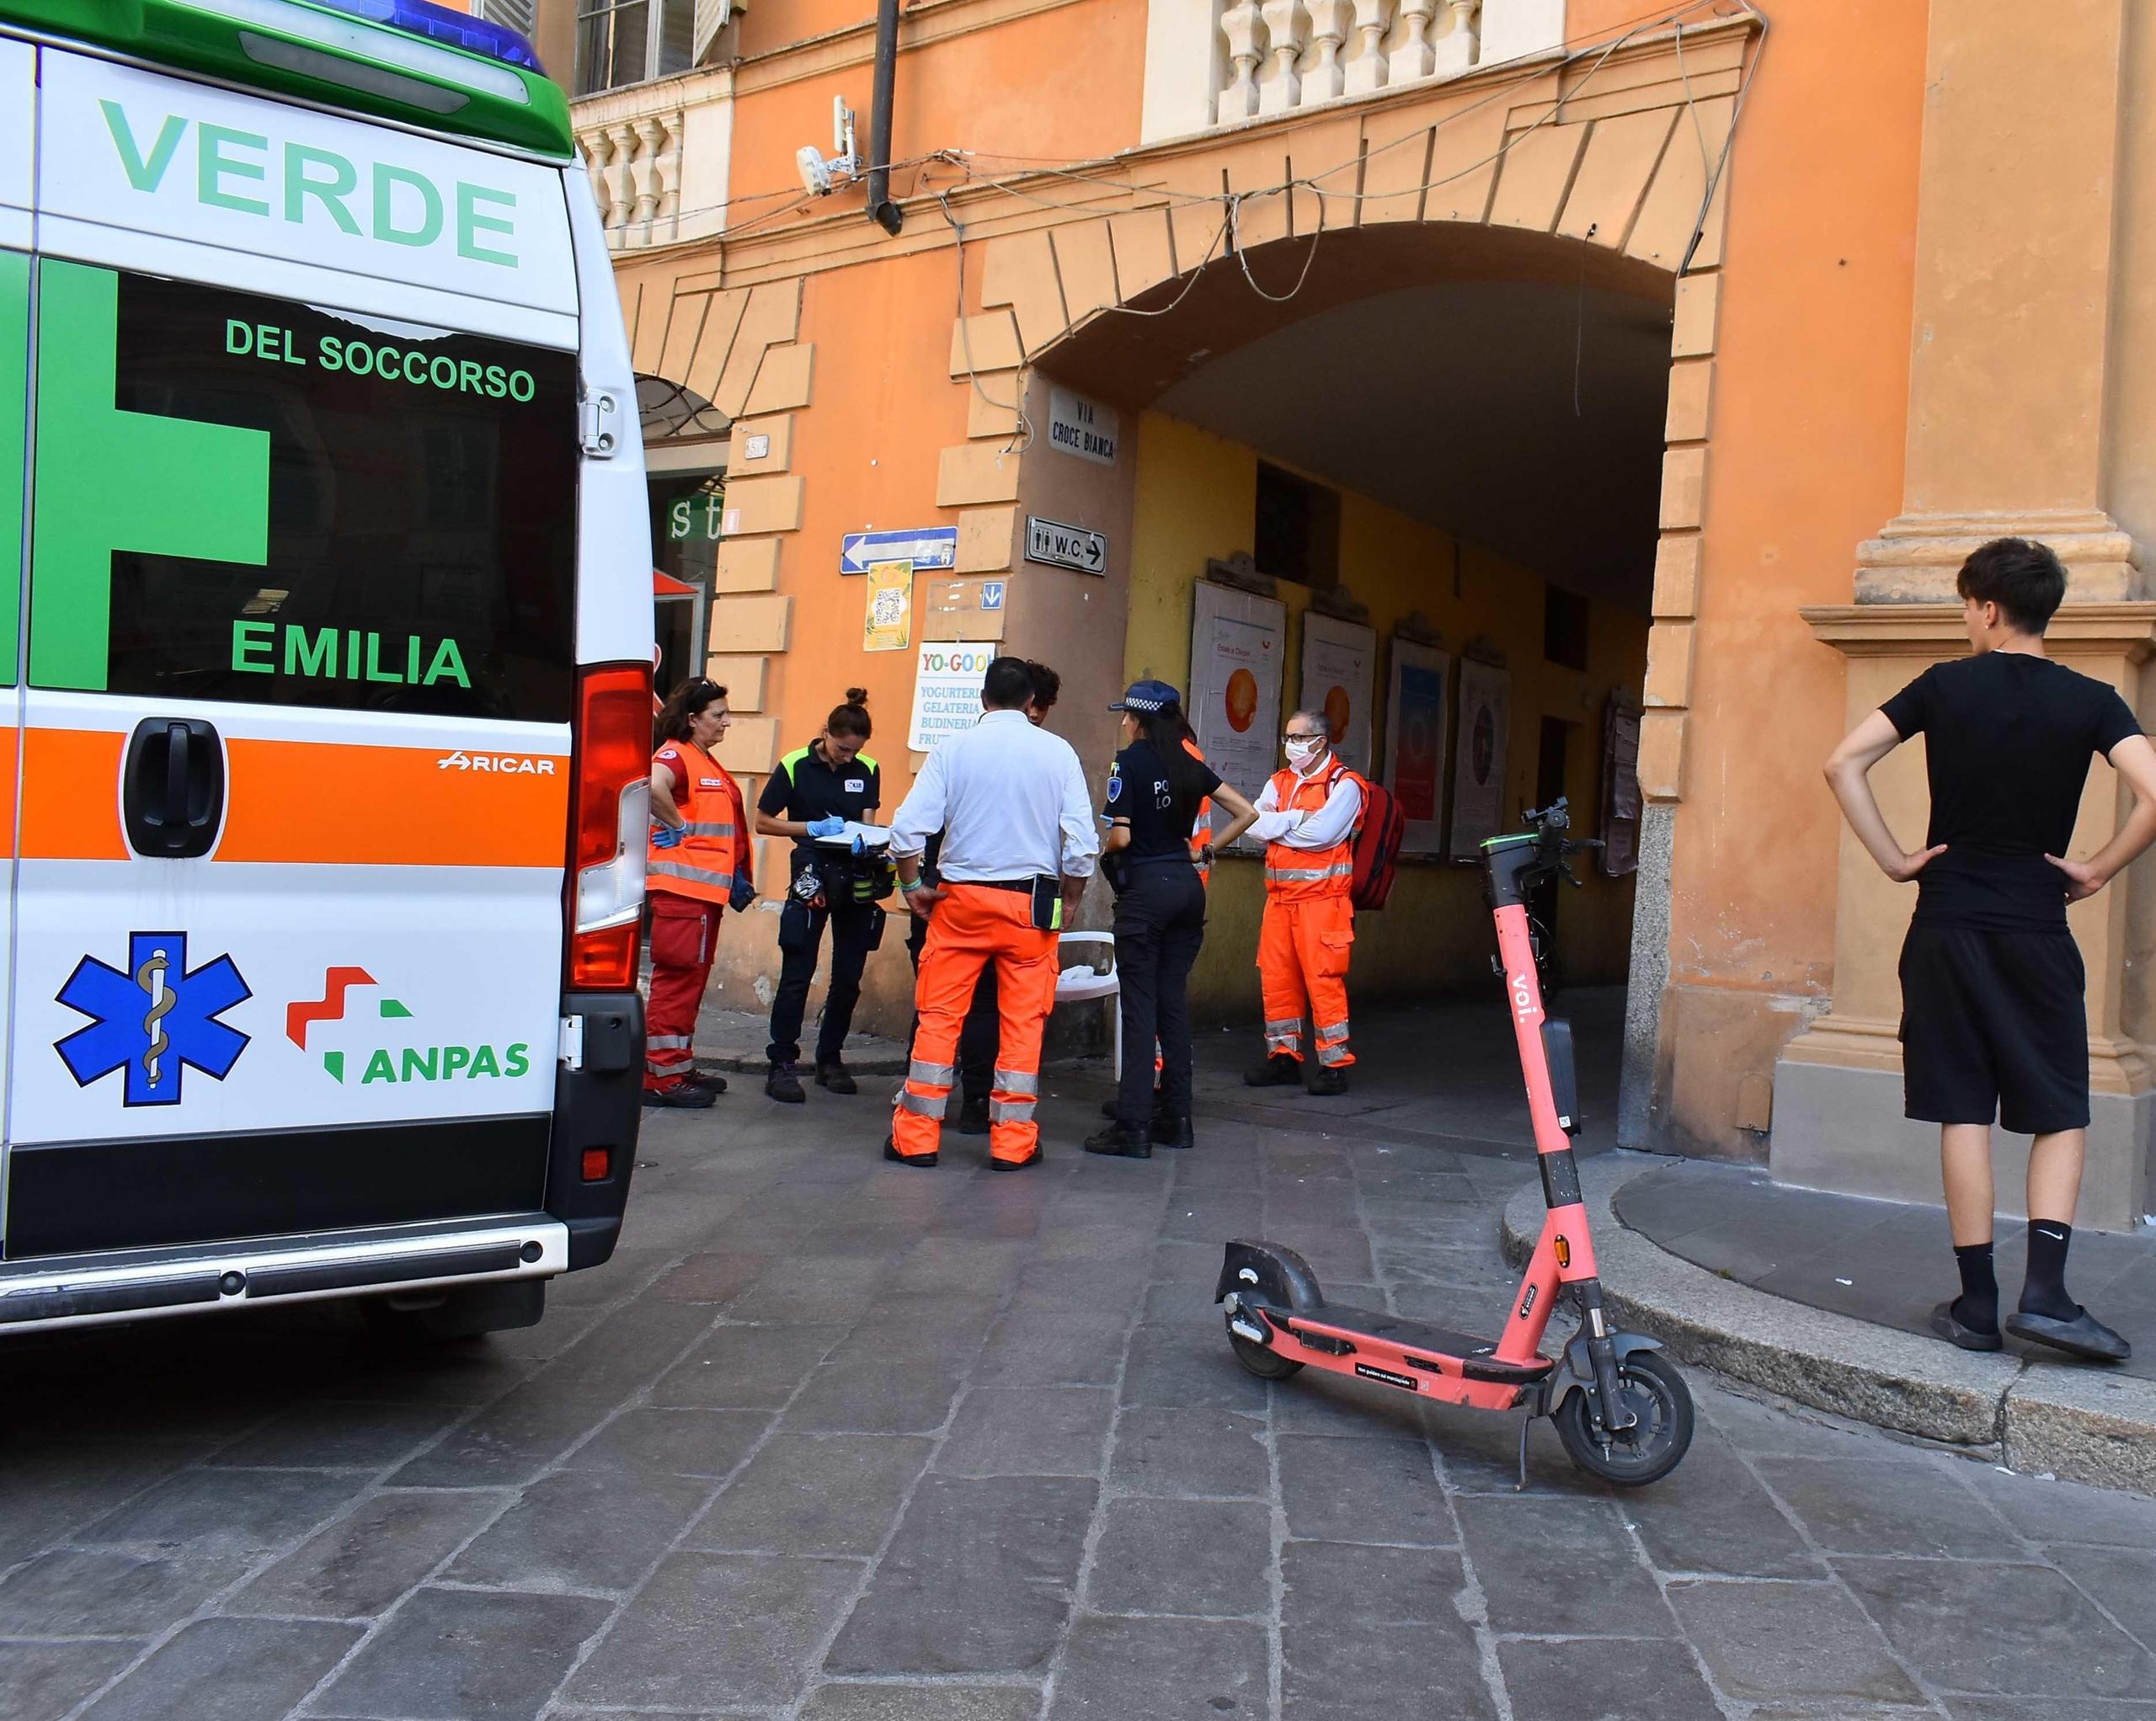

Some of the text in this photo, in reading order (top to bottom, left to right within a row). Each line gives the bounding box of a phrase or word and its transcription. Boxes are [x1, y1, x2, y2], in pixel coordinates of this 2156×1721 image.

[99, 99, 520, 269] VERDE
[226, 318, 535, 402] DEL SOCCORSO
[1077, 401, 1094, 424] VIA
[1053, 421, 1113, 459] CROCE BIANCA
[1055, 535, 1084, 558] W.C.
[232, 620, 472, 688] EMILIA
[921, 686, 980, 699] YOGURTERI
[923, 701, 980, 715] GELATERIA
[436, 751, 555, 775] ARICAR
[360, 1042, 530, 1084] ANPAS
